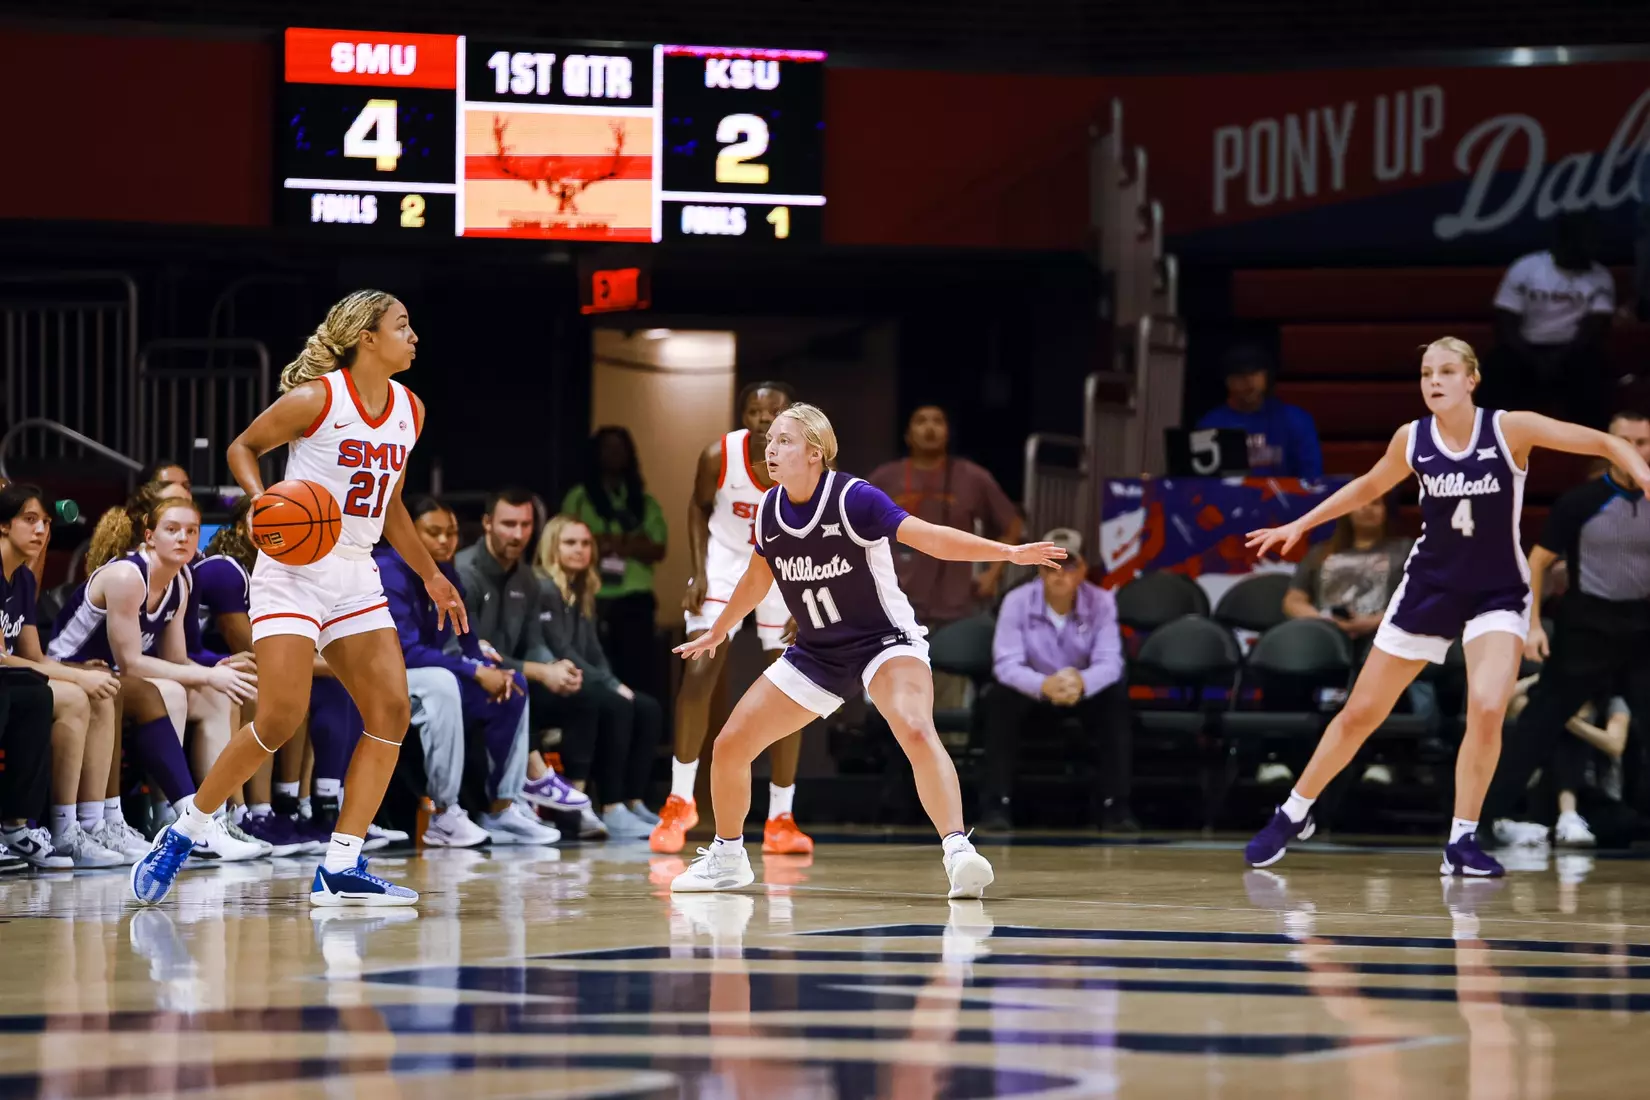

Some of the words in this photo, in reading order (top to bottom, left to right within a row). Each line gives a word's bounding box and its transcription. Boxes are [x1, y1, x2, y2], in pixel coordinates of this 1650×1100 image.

[331, 42, 417, 75] SMU
[488, 51, 556, 95] 1ST
[562, 54, 633, 98] QTR
[704, 58, 781, 90] KSU
[344, 98, 402, 171] 4
[715, 113, 769, 184] 2
[1213, 102, 1357, 213] PONY
[1374, 85, 1443, 181] UP
[400, 194, 425, 227] 2
[766, 206, 790, 239] 1
[337, 438, 407, 472] SMU
[1188, 428, 1221, 476] 5
[343, 471, 390, 518] 21
[1423, 471, 1501, 498] Wildcats
[1451, 499, 1475, 536] 4
[775, 553, 853, 582] Wildcats
[801, 586, 842, 629] 11
